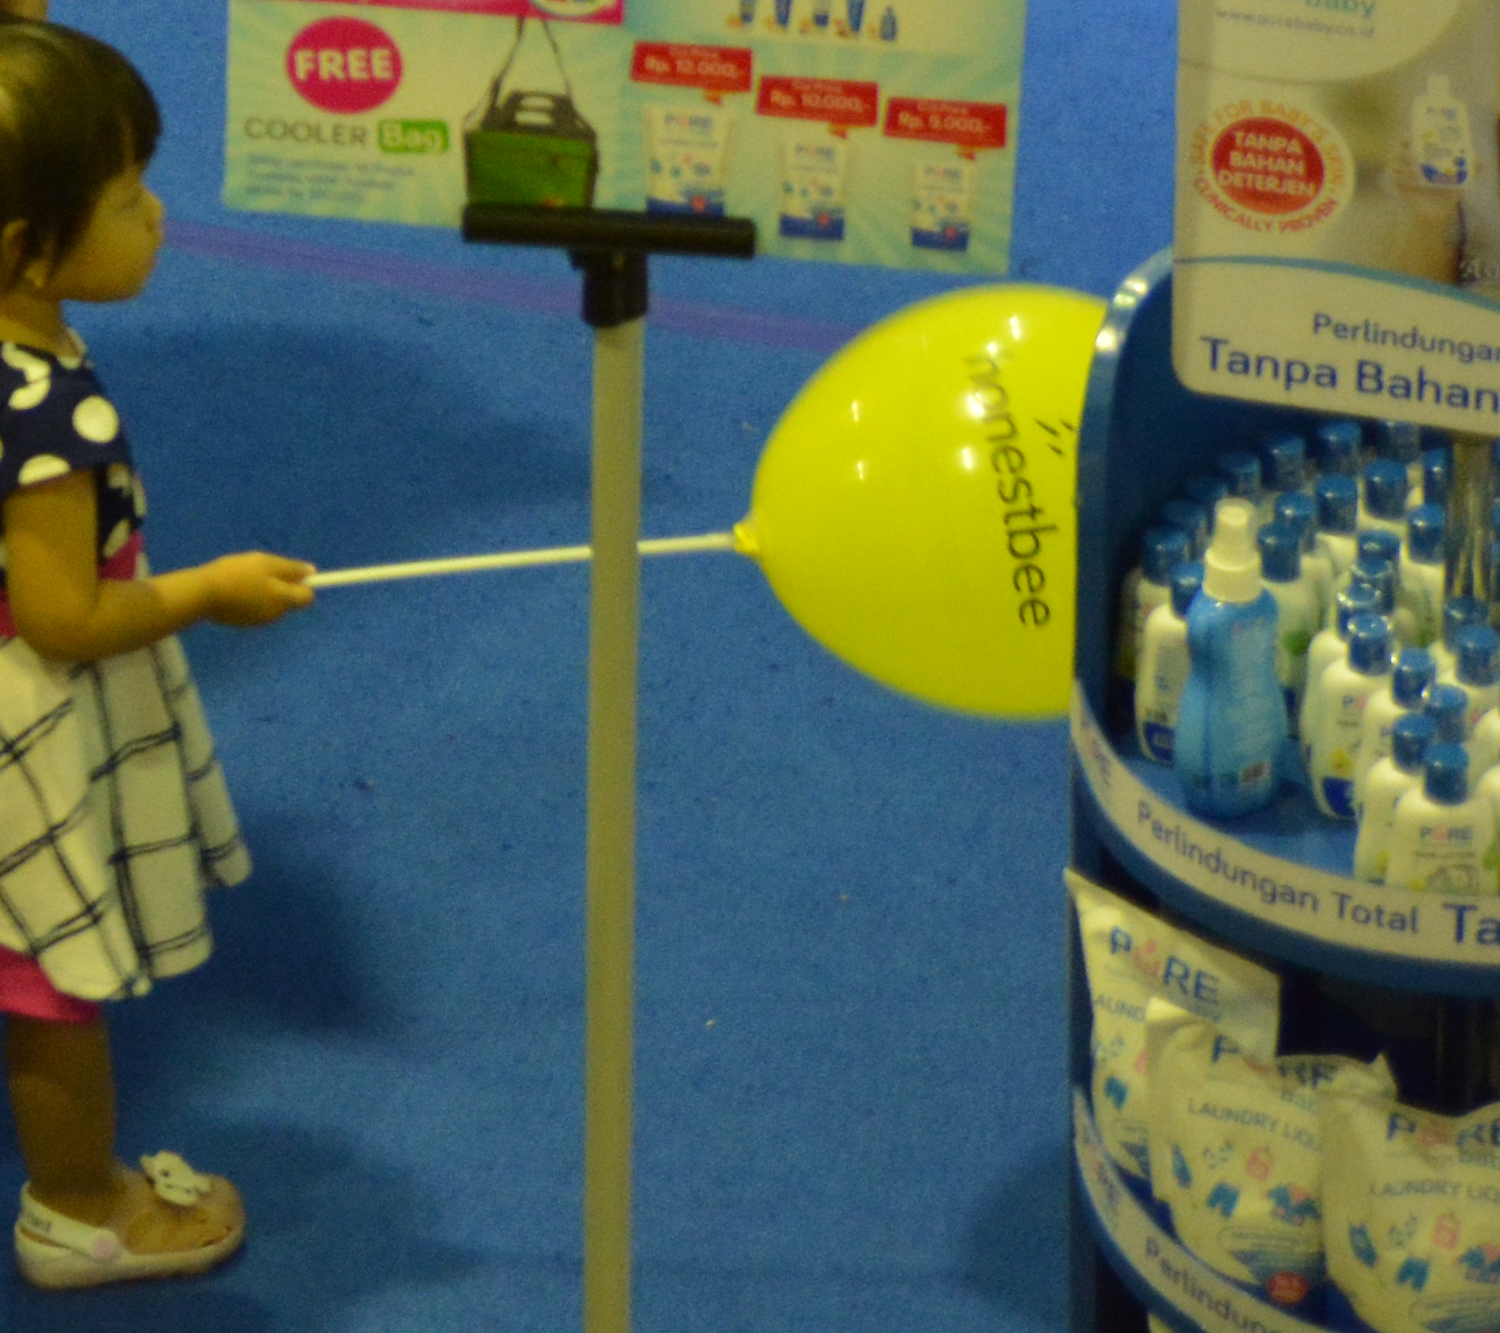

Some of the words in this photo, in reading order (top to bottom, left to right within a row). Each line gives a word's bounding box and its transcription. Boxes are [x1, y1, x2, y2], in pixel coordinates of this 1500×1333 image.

[294, 48, 394, 82] FREE
[244, 117, 367, 146] COOLER
[1235, 132, 1301, 154] TANPA
[1229, 151, 1306, 175] BAHAN
[1218, 169, 1316, 196] DETERJEN
[1200, 336, 1339, 392] Tanpa
[1136, 800, 1319, 915] Perlindungan
[1331, 889, 1419, 934] Total
